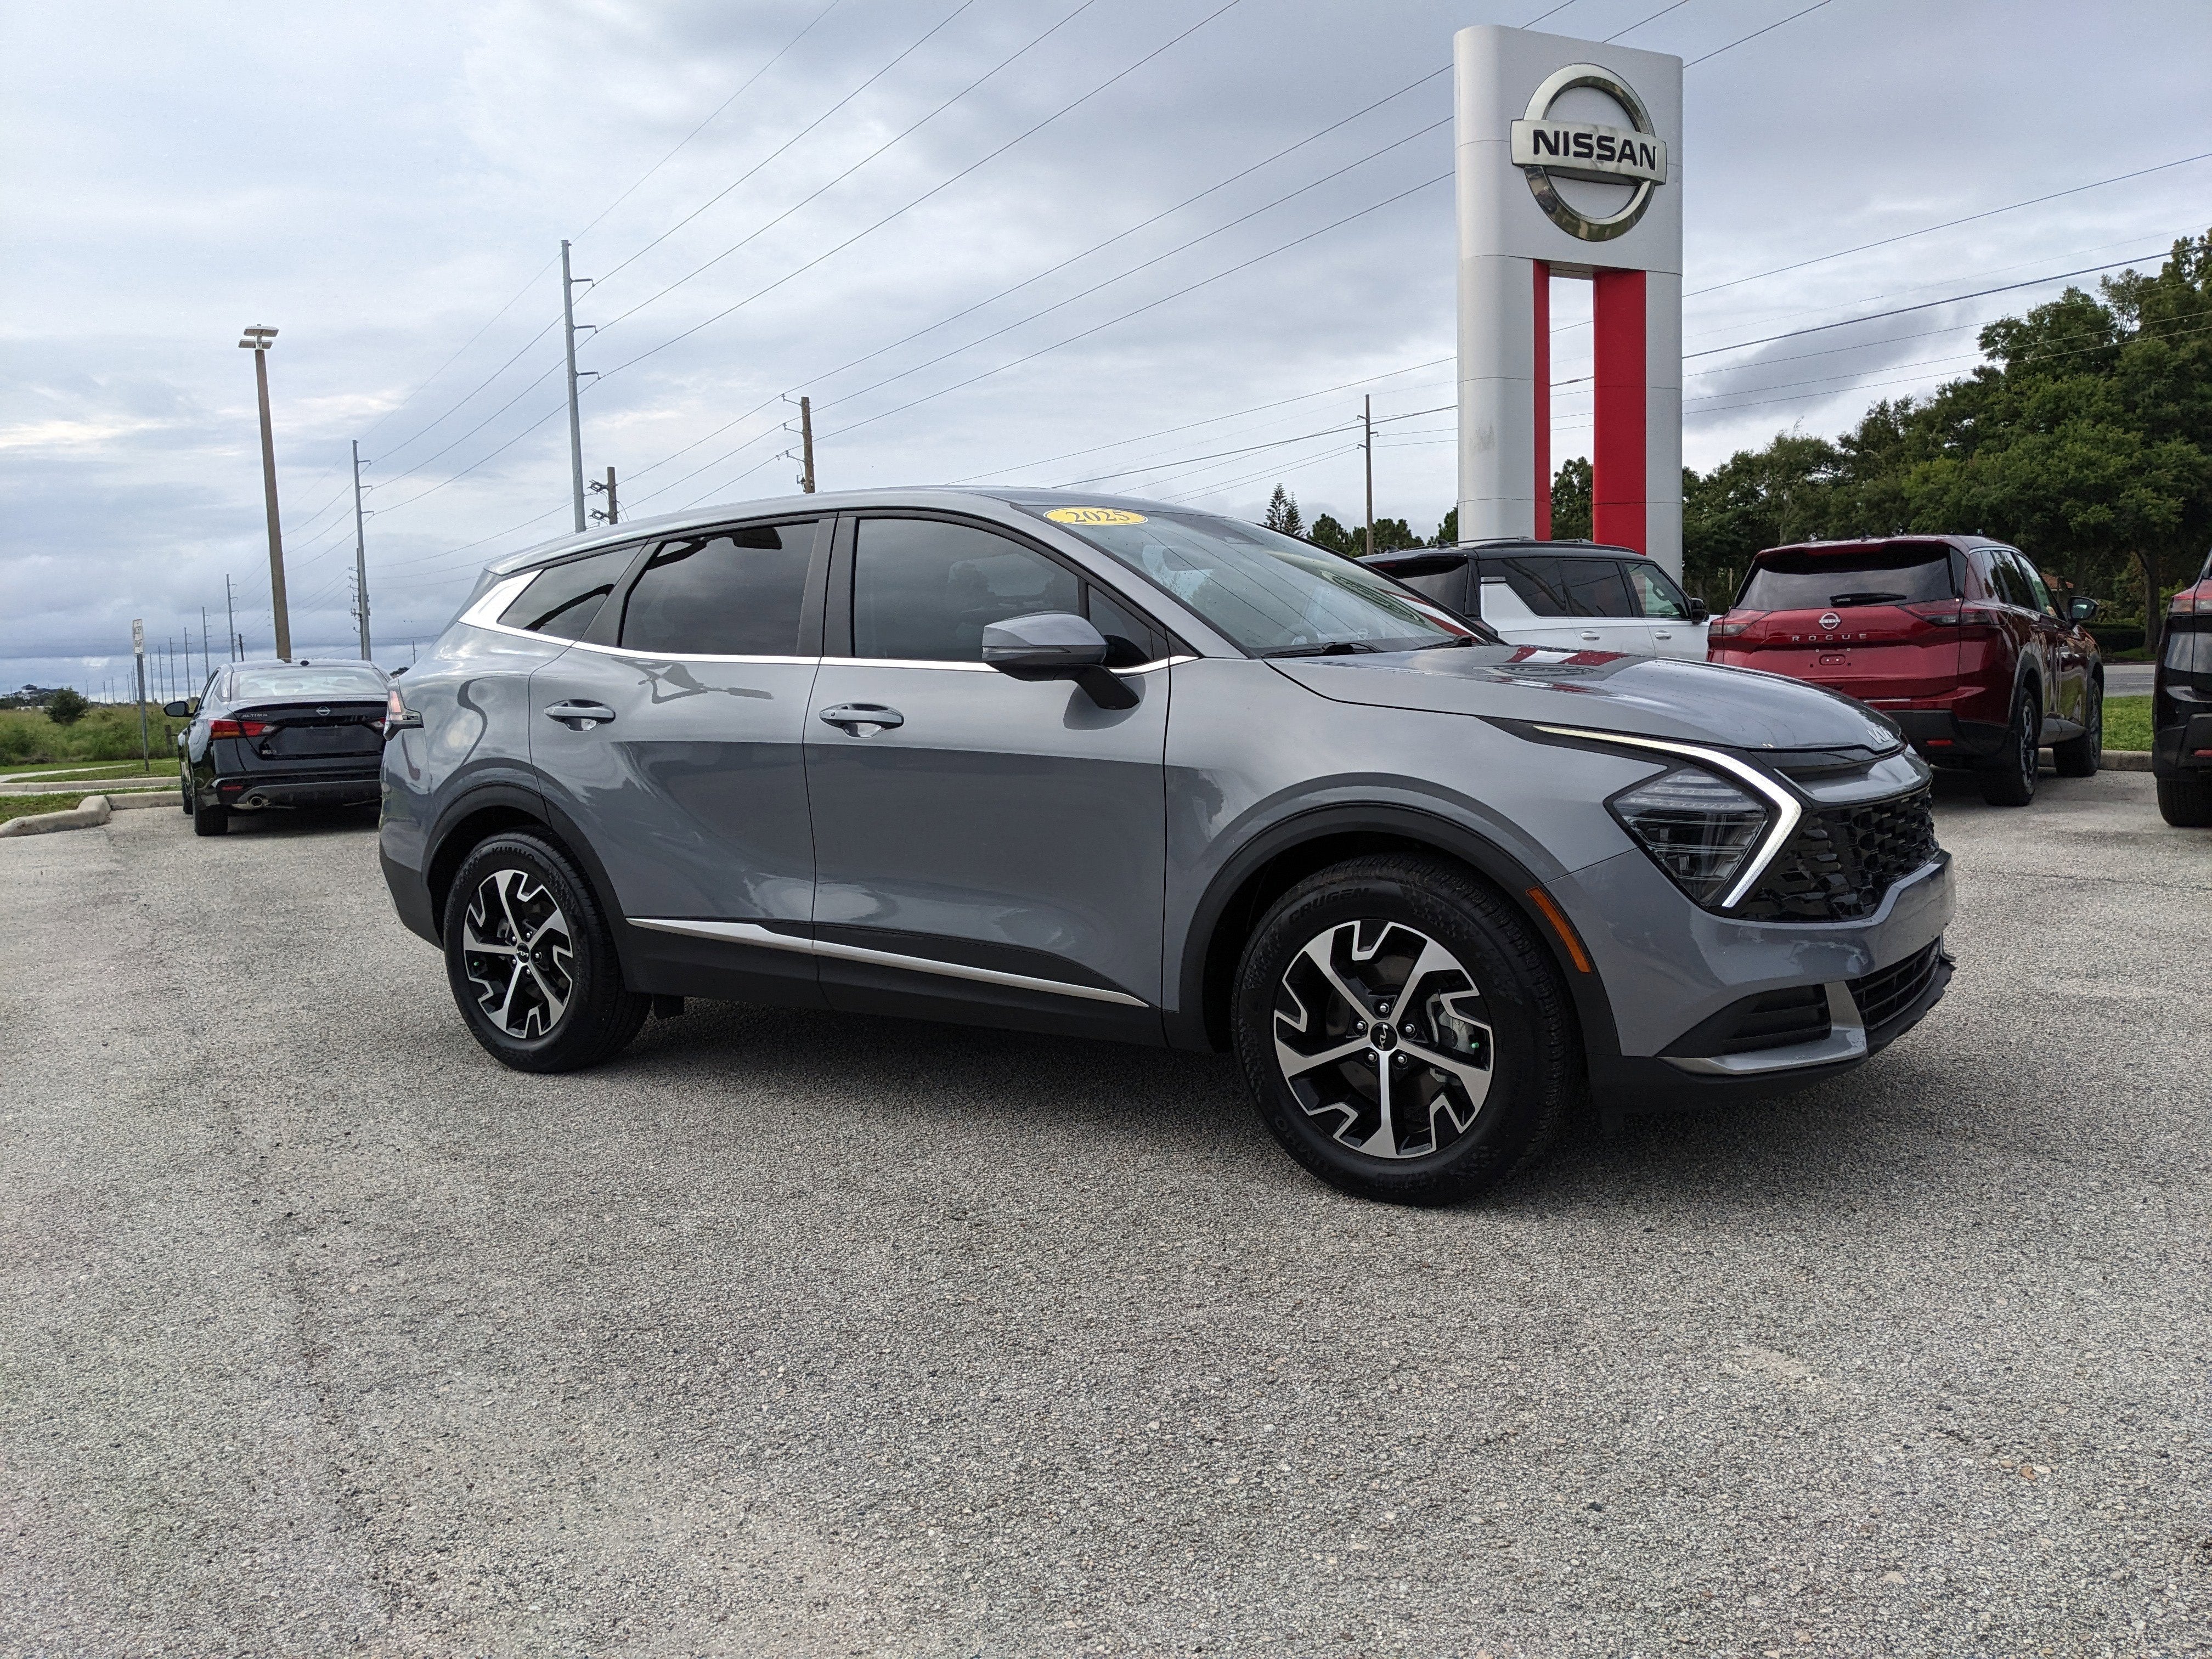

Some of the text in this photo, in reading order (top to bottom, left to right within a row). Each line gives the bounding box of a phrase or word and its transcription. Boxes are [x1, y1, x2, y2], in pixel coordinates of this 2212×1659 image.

[1532, 129, 1657, 171] NISSAN
[1065, 511, 1130, 522] 2025
[1792, 633, 1867, 642] ROGUE
